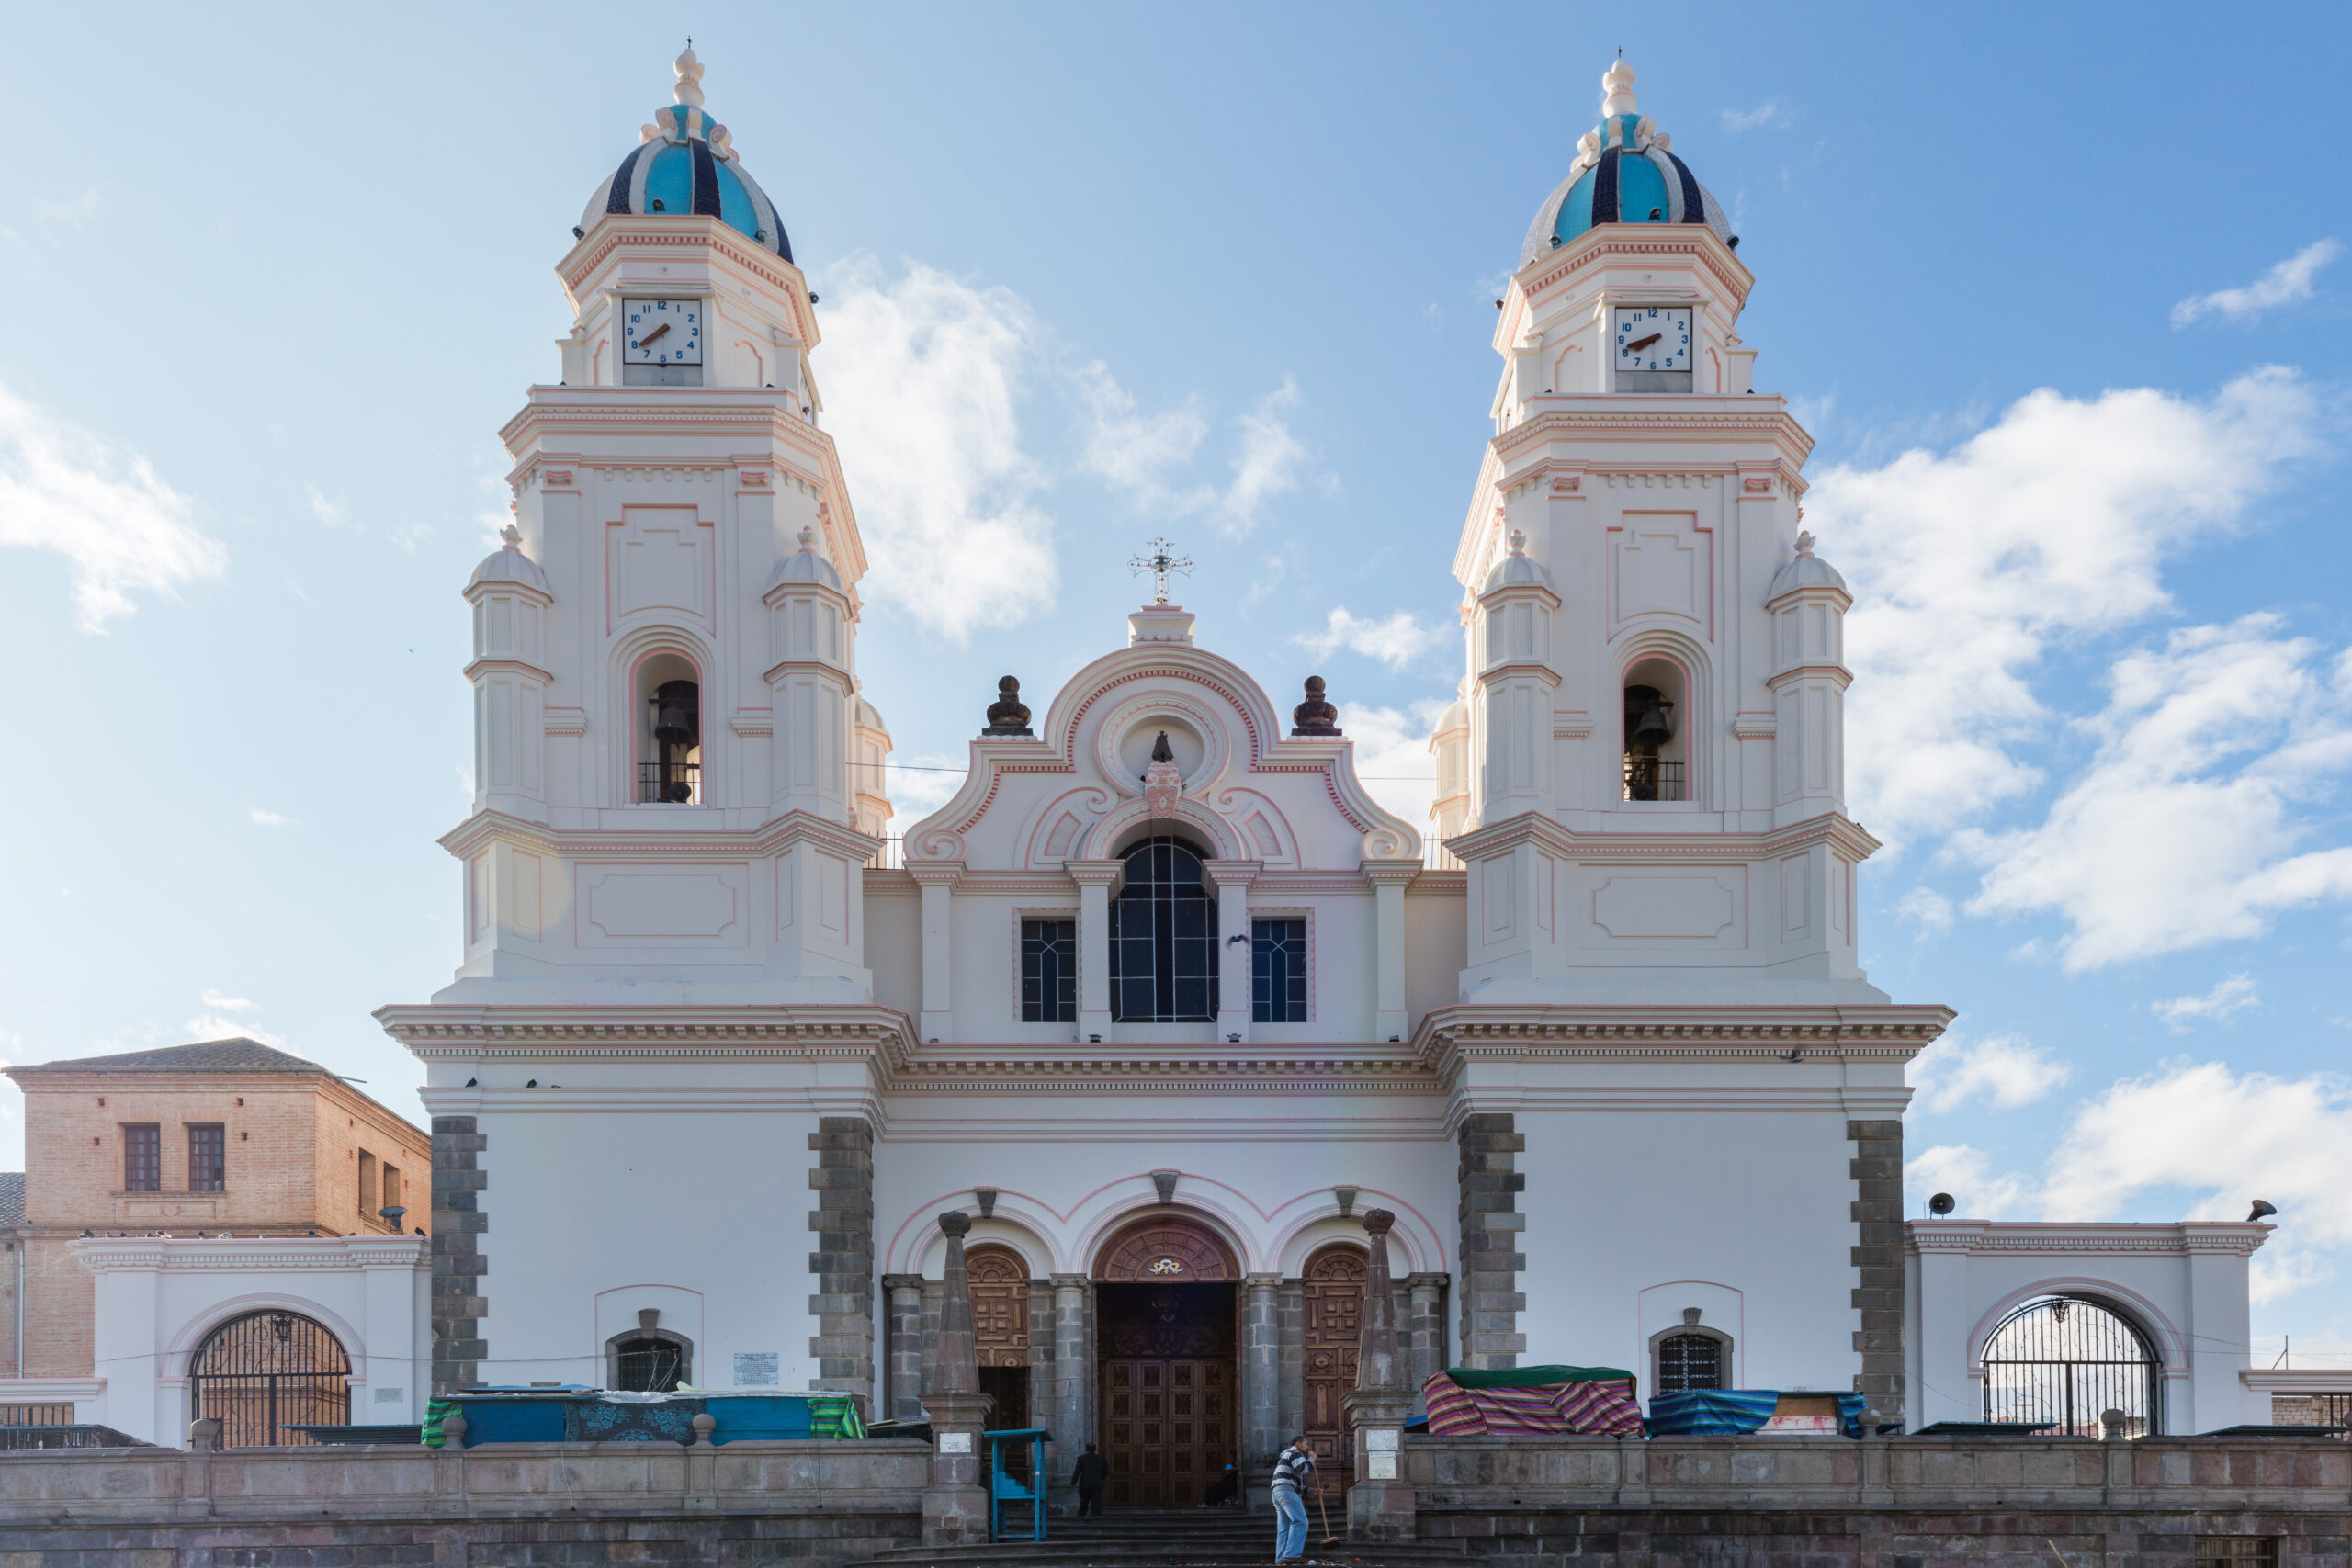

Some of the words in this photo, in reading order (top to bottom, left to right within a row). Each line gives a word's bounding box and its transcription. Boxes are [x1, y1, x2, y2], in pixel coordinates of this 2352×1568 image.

[643, 305, 651, 313] 11
[657, 300, 667, 310] 12
[687, 314, 695, 322] 2
[1634, 313, 1641, 321] 11
[1648, 309, 1657, 318] 12
[630, 314, 640, 323] 10
[1622, 322, 1632, 332] 10
[1678, 321, 1684, 330] 2
[627, 327, 634, 336] 9
[692, 327, 698, 336] 3
[1618, 335, 1624, 344] 9
[1681, 335, 1688, 344] 3
[631, 341, 638, 349] 8
[687, 341, 694, 349] 4
[644, 349, 650, 358] 7
[676, 350, 683, 359] 5
[1622, 349, 1629, 357] 8
[660, 354, 666, 362] 6
[1634, 357, 1641, 366] 7
[1666, 357, 1672, 367] 5
[1650, 362, 1657, 370] 6
